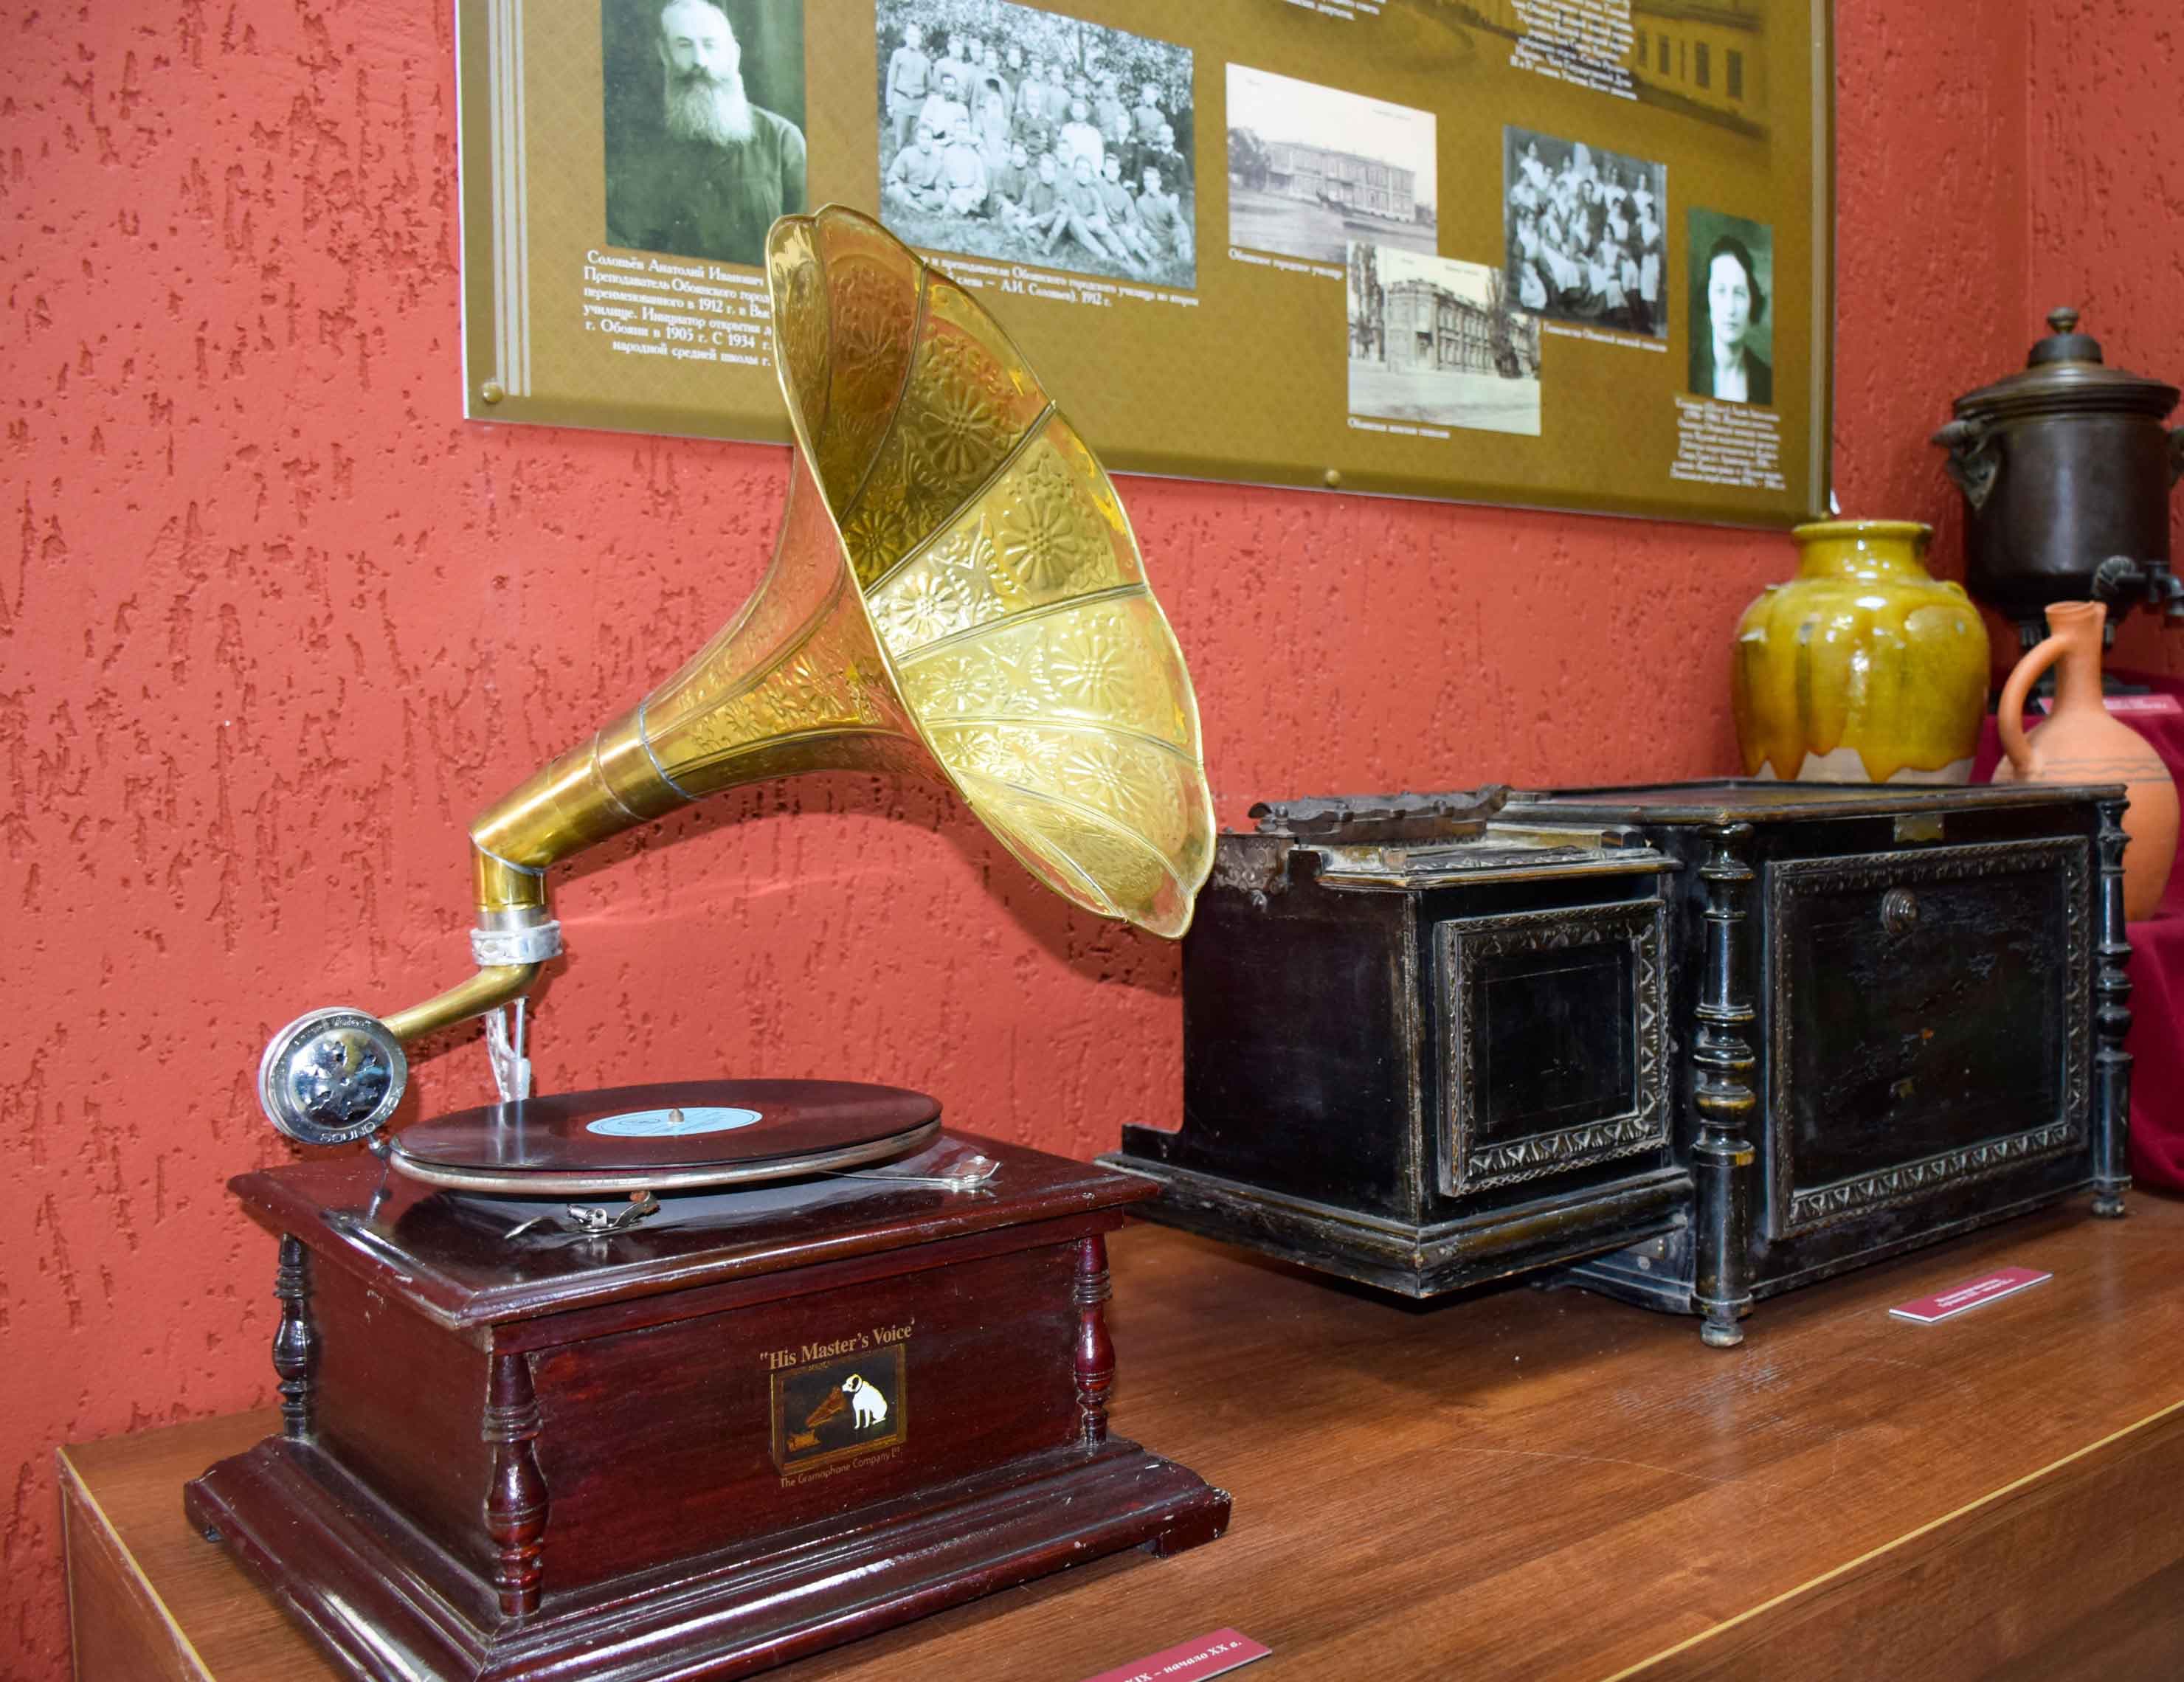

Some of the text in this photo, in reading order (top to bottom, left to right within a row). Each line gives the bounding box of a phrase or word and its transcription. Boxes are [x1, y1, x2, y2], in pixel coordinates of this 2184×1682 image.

[698, 297, 724, 314] 1912
[779, 1477, 796, 1489] The
[798, 1464, 851, 1484] Gramophone
[852, 1450, 891, 1470] Company
[1163, 1652, 1209, 1674] начало
